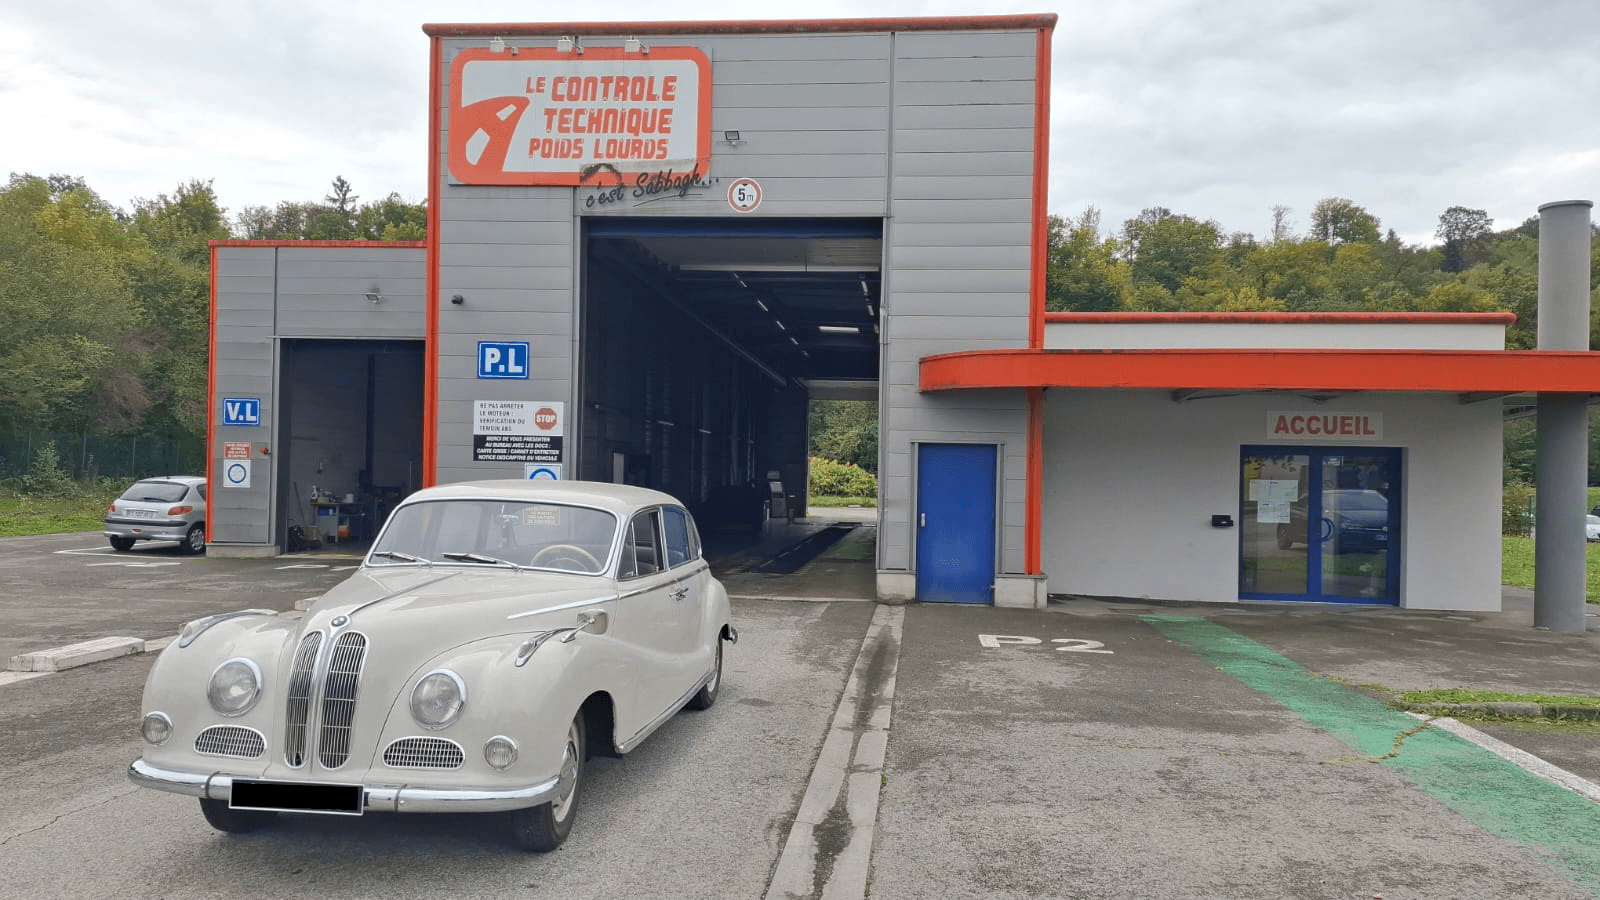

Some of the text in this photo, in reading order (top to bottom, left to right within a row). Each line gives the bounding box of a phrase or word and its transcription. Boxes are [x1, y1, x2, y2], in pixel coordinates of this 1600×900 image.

[526, 75, 678, 102] LE CONTROLE
[543, 108, 673, 137] TECHNIQUE
[528, 138, 669, 160] POIDS LOURDS
[585, 181, 624, 208] c'est
[485, 347, 523, 373] P.L
[226, 402, 257, 422] V.L
[536, 414, 556, 423] STOP
[1274, 415, 1376, 436] ACCUEIL
